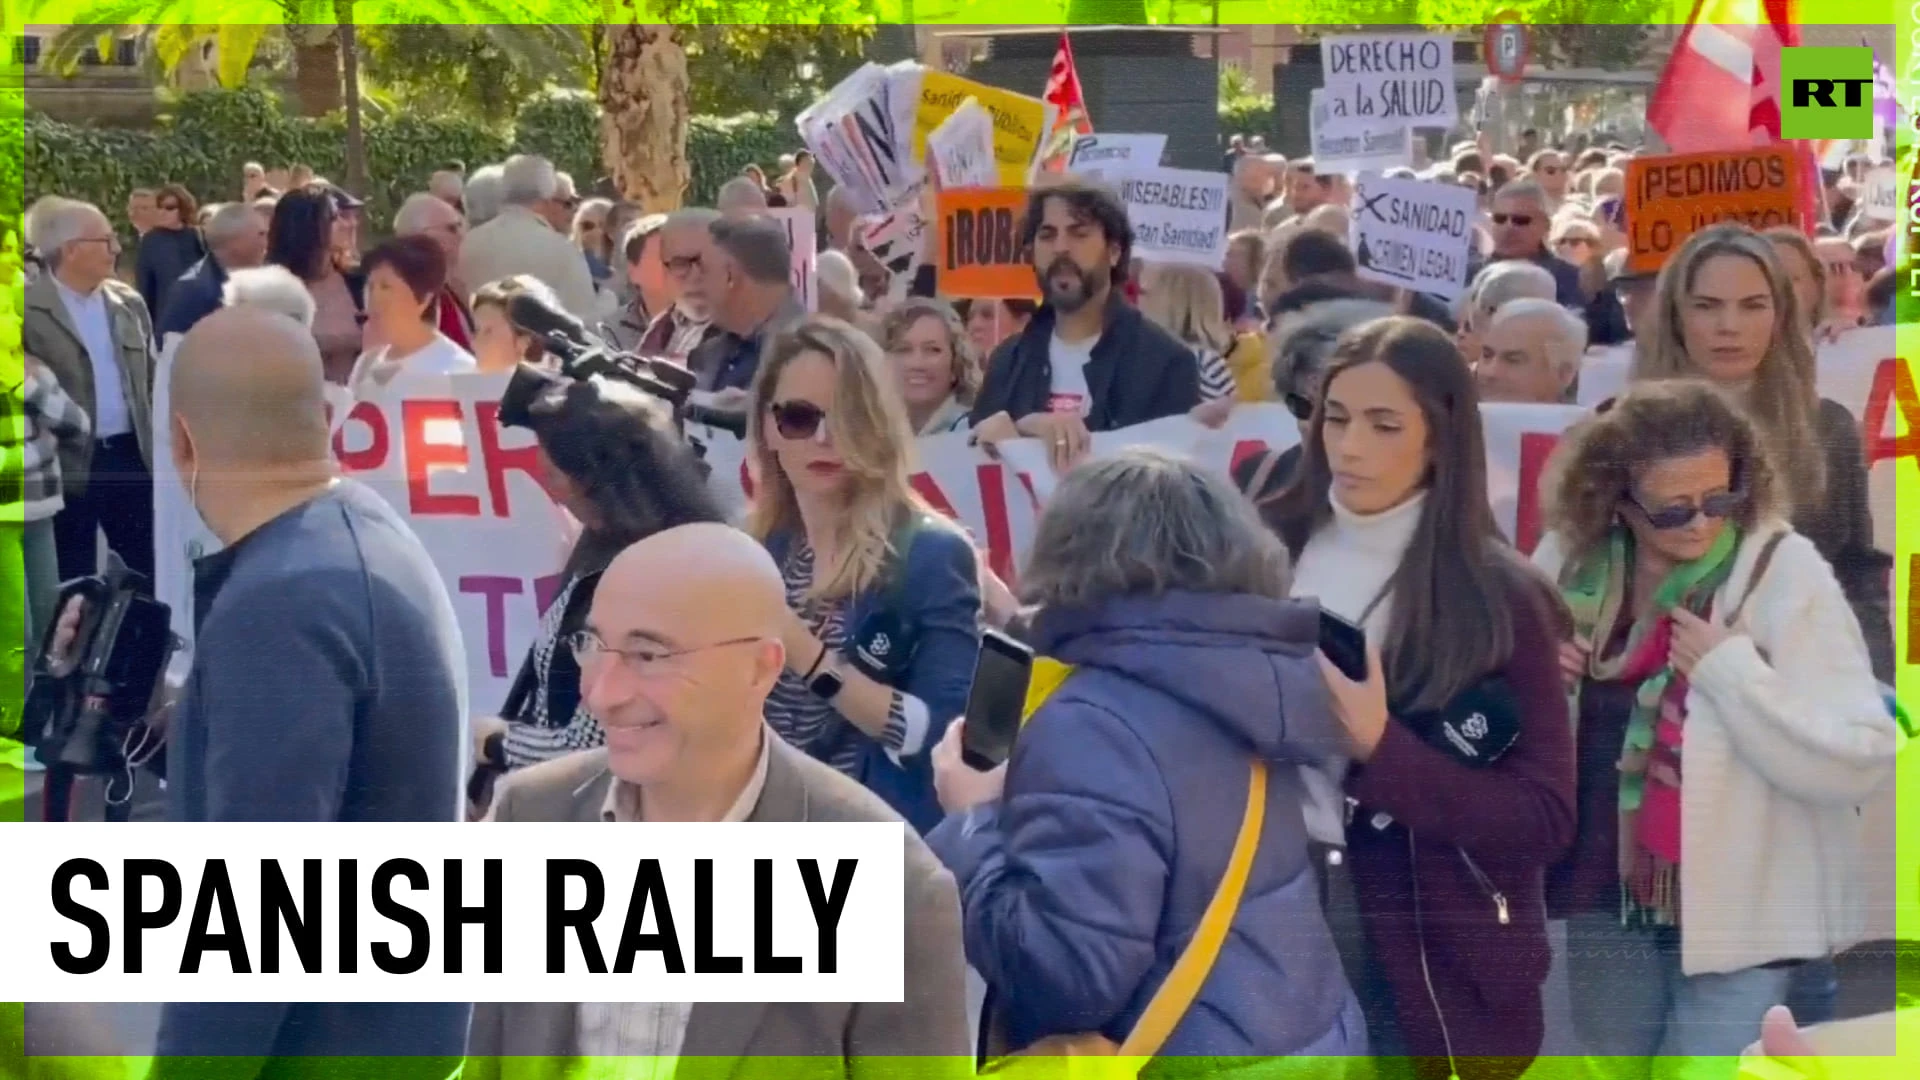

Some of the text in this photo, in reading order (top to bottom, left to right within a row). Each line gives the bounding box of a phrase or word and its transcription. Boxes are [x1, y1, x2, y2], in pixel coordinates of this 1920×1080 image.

[1329, 40, 1441, 74] DERECHO
[1333, 98, 1347, 117] a
[1356, 82, 1374, 116] la
[1632, 219, 1673, 253] LO
